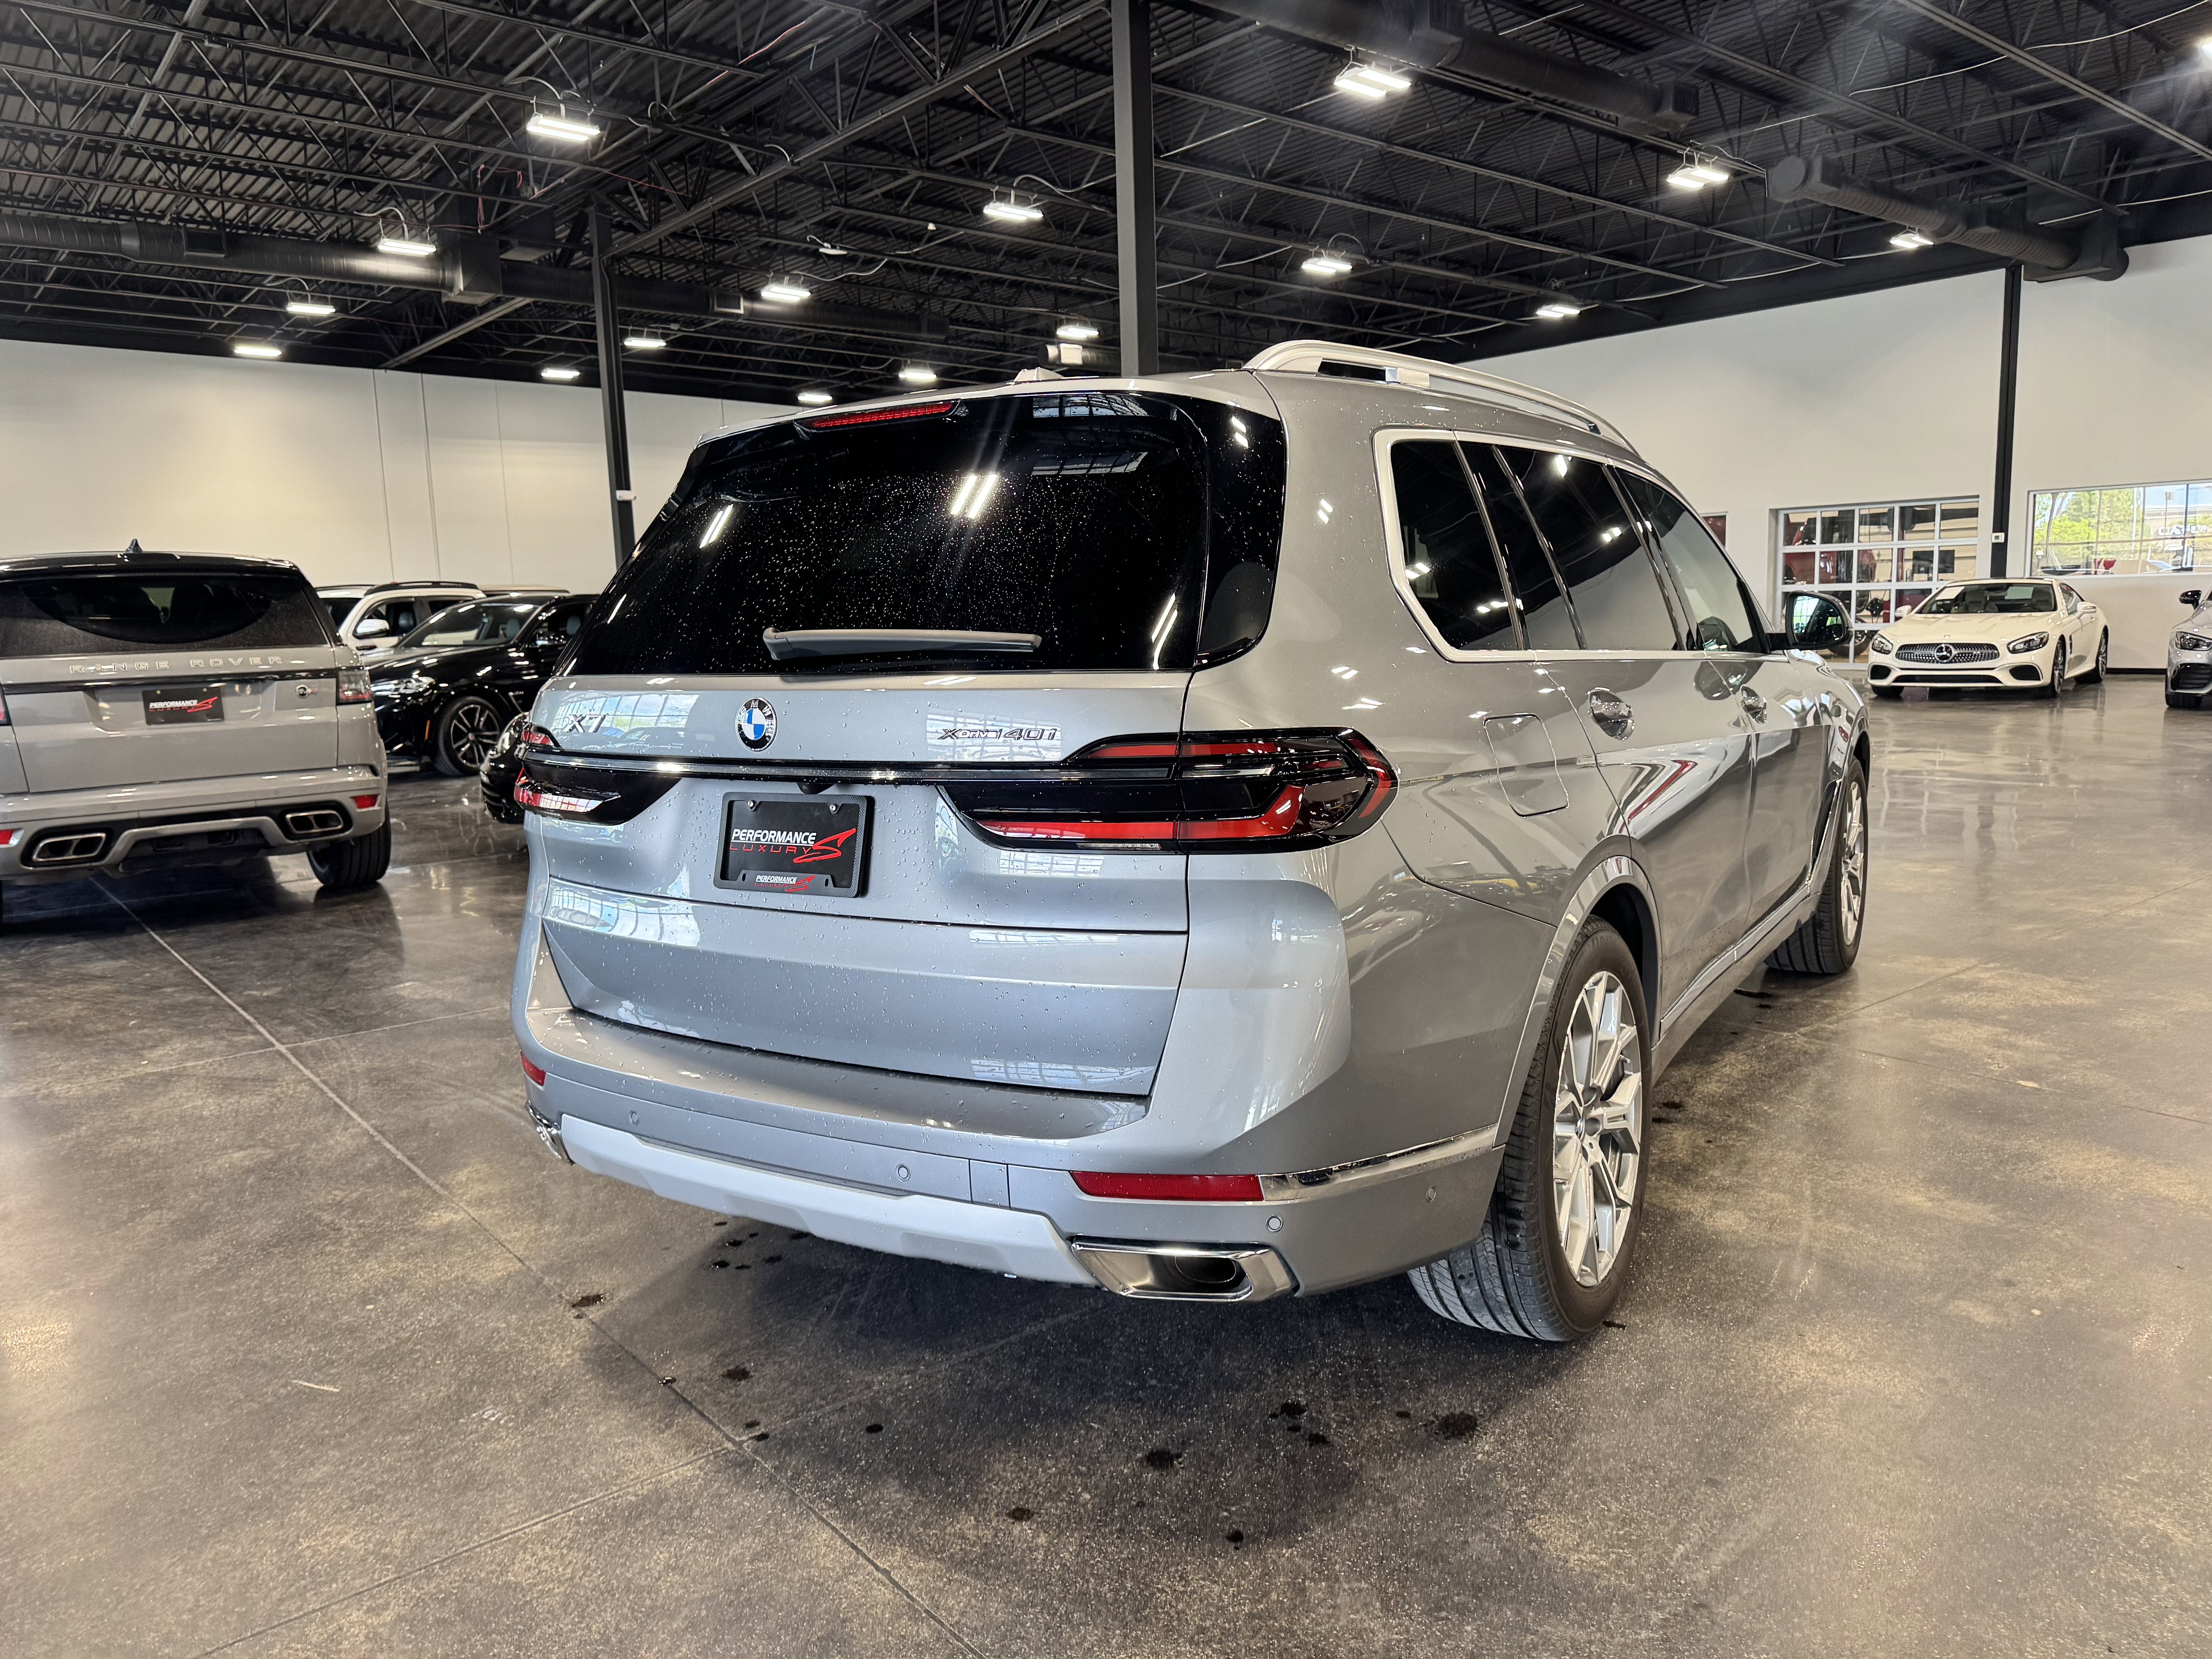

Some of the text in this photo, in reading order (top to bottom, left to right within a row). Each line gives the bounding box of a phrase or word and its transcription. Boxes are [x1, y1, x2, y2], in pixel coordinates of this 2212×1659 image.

[70, 656, 282, 673] RANGE ROVER
[149, 699, 198, 709] PERFORMANCE
[563, 714, 606, 733] X7
[731, 828, 817, 845] PERFORMANCE
[729, 843, 812, 854] LUXURY
[756, 875, 797, 884] PERFORMANCE
